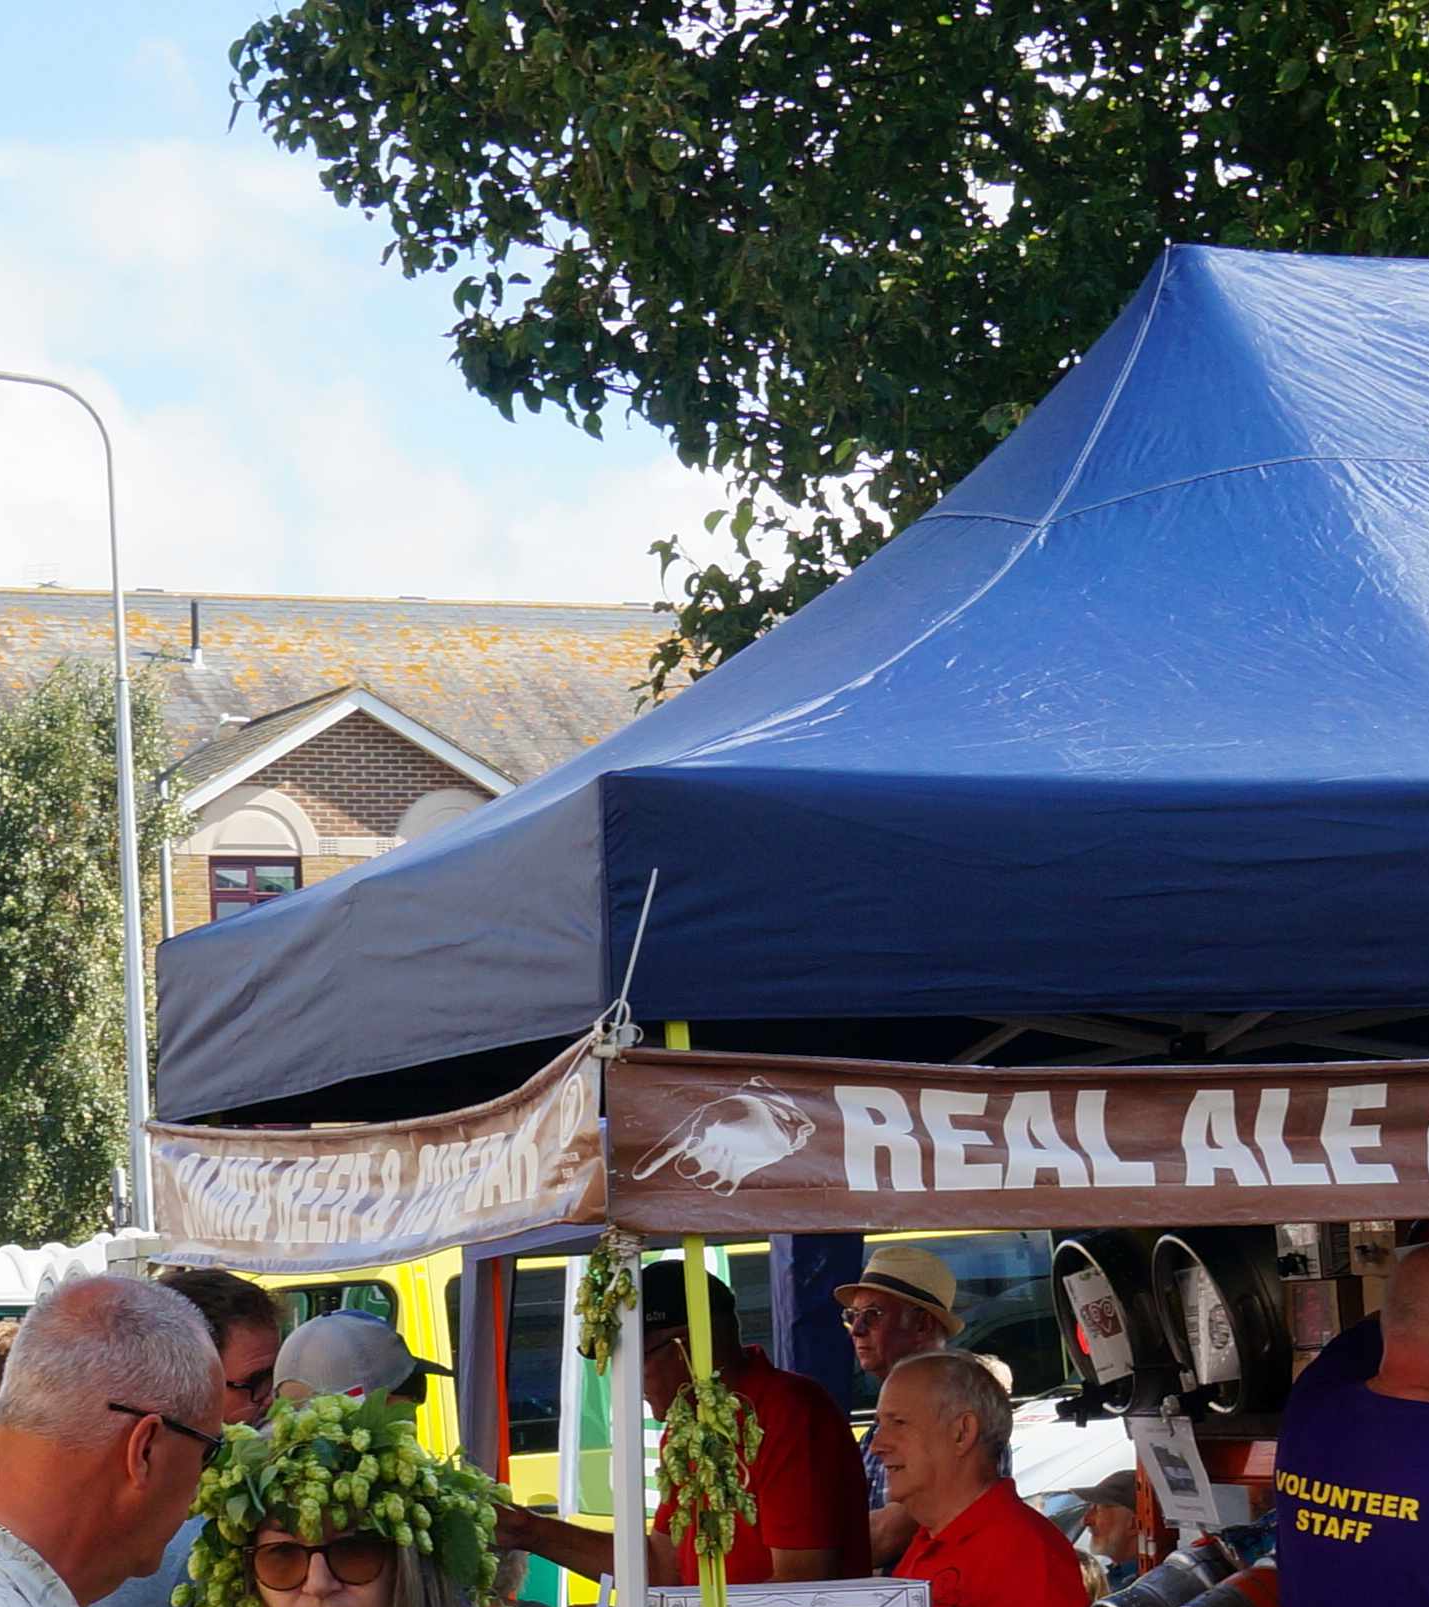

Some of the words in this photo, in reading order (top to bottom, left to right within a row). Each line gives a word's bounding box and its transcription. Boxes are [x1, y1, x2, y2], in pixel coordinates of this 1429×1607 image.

[834, 1085, 1155, 1192] REAL
[1180, 1083, 1399, 1187] ALE
[275, 1152, 372, 1244] BEER
[359, 1148, 402, 1244] &
[1275, 1469, 1420, 1521] VOLUNTEER
[1295, 1508, 1372, 1543] STAFF
